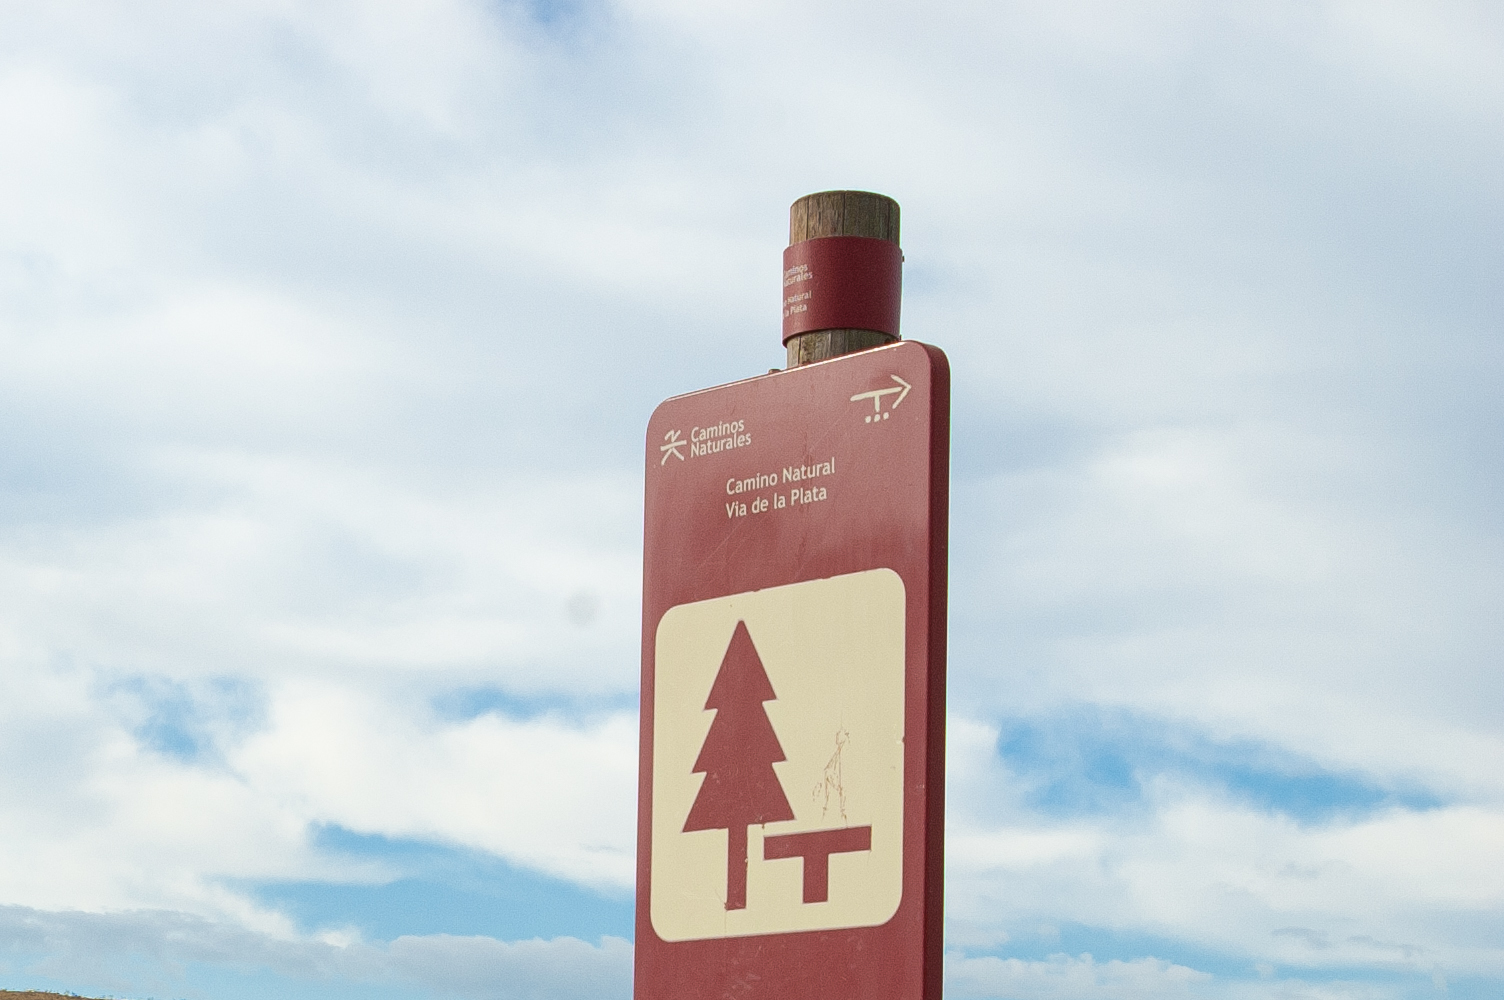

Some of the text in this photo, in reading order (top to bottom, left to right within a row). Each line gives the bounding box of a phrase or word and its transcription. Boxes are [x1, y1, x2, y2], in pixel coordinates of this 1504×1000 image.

[691, 419, 745, 442] Caminos
[690, 433, 751, 458] Naturales
[726, 457, 836, 495] Camino Natural
[751, 497, 768, 514] de
[773, 492, 786, 510] la
[790, 487, 827, 506] Plata
